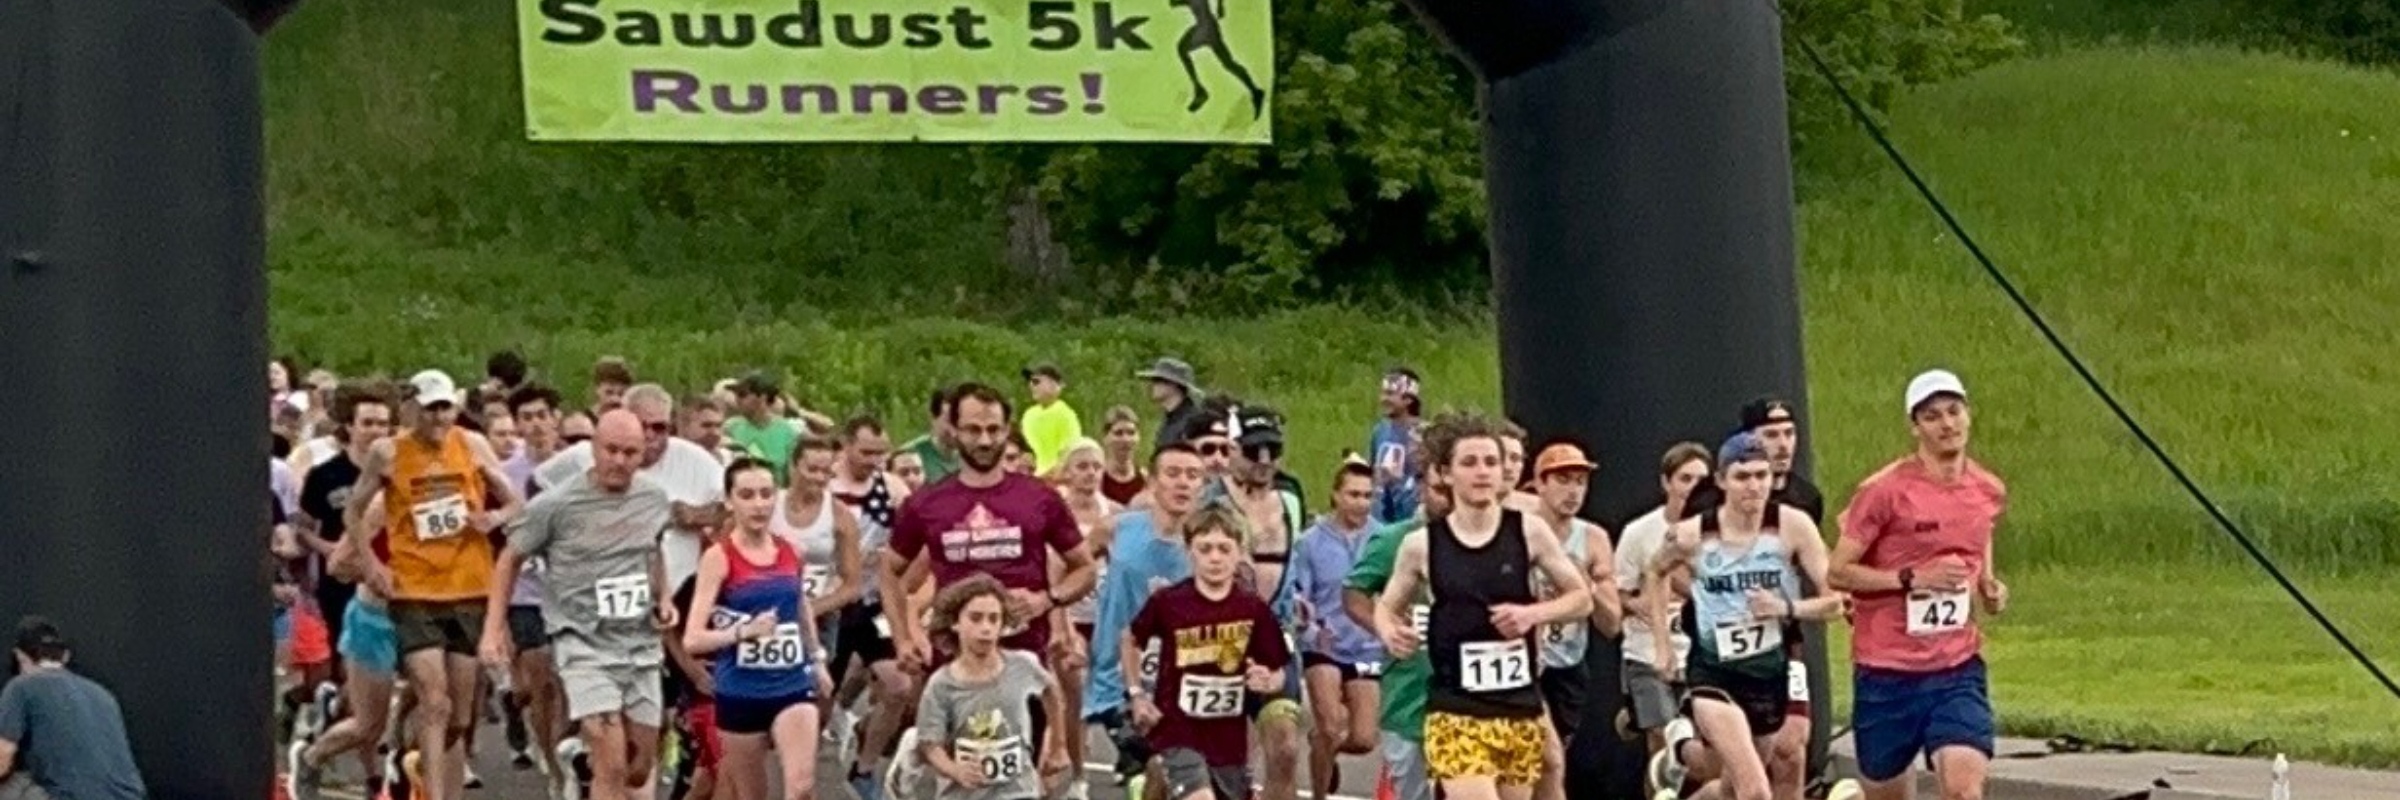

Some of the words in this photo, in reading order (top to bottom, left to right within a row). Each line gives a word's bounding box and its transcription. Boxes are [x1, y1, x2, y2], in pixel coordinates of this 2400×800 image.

[538, 0, 992, 49] Sawdust
[1027, 0, 1153, 51] 5k
[631, 69, 1105, 115] Runners!
[427, 510, 459, 535] 86
[1922, 600, 1957, 626] 42
[742, 638, 798, 664] 360
[1730, 624, 1765, 654] 57
[1468, 655, 1523, 685] 112
[1186, 690, 1240, 714] 123
[960, 753, 1017, 779] 08
